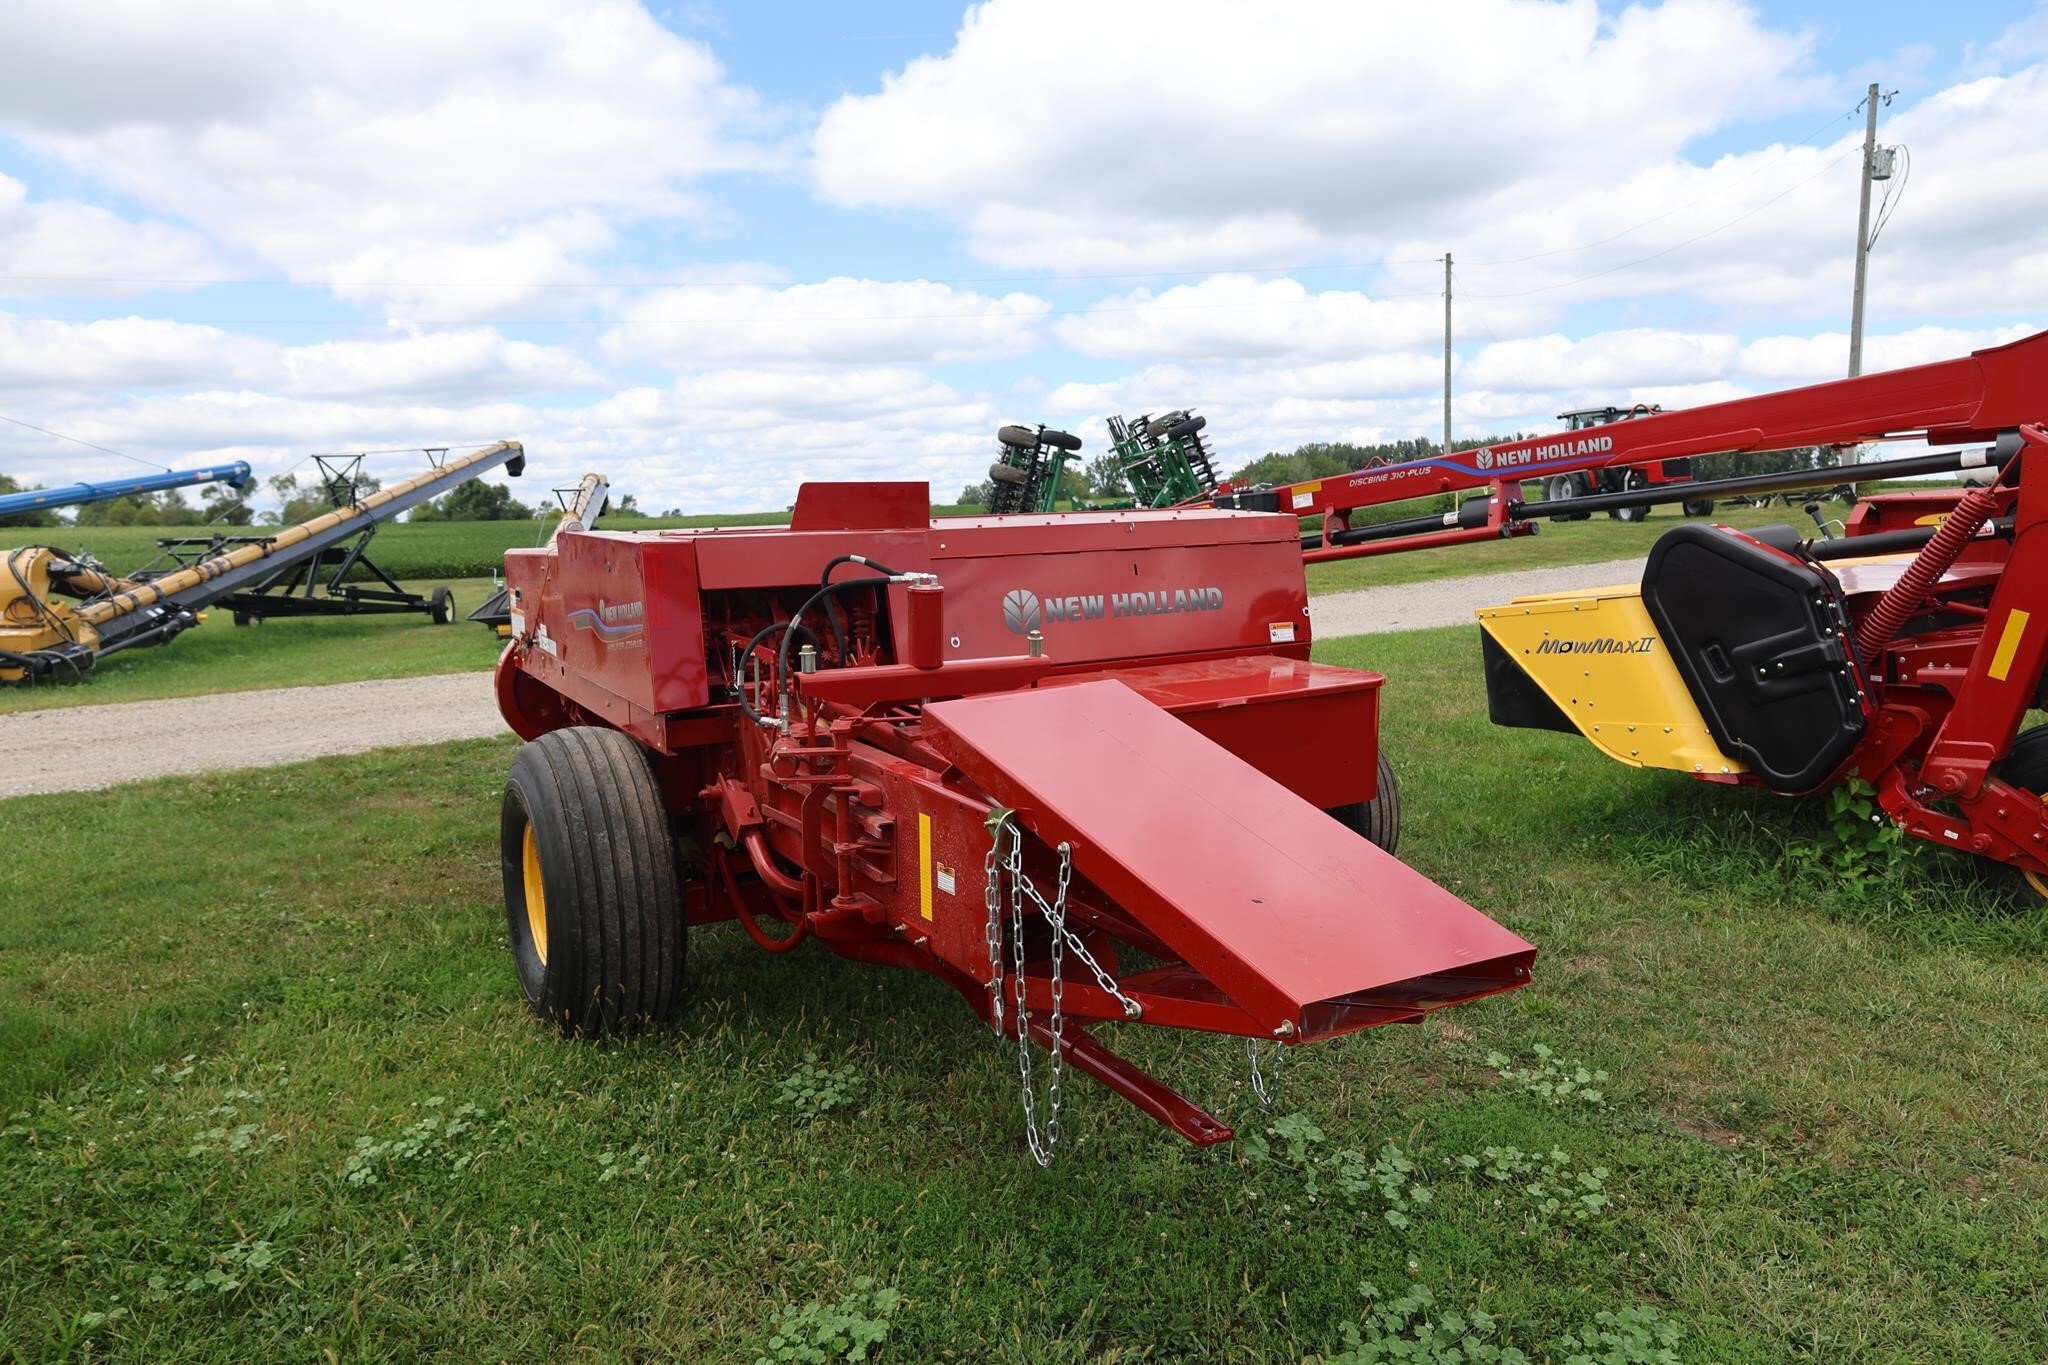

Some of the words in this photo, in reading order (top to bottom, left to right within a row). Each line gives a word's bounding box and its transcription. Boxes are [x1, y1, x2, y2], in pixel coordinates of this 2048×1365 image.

[1496, 449, 1531, 467] NEW
[1536, 437, 1613, 461] HOLLAND
[1349, 474, 1388, 488] DISCBINE
[1390, 471, 1405, 480] 310
[1407, 466, 1432, 477] PLUS
[1045, 595, 1104, 623] NEW
[1111, 587, 1224, 618] HOLLAND
